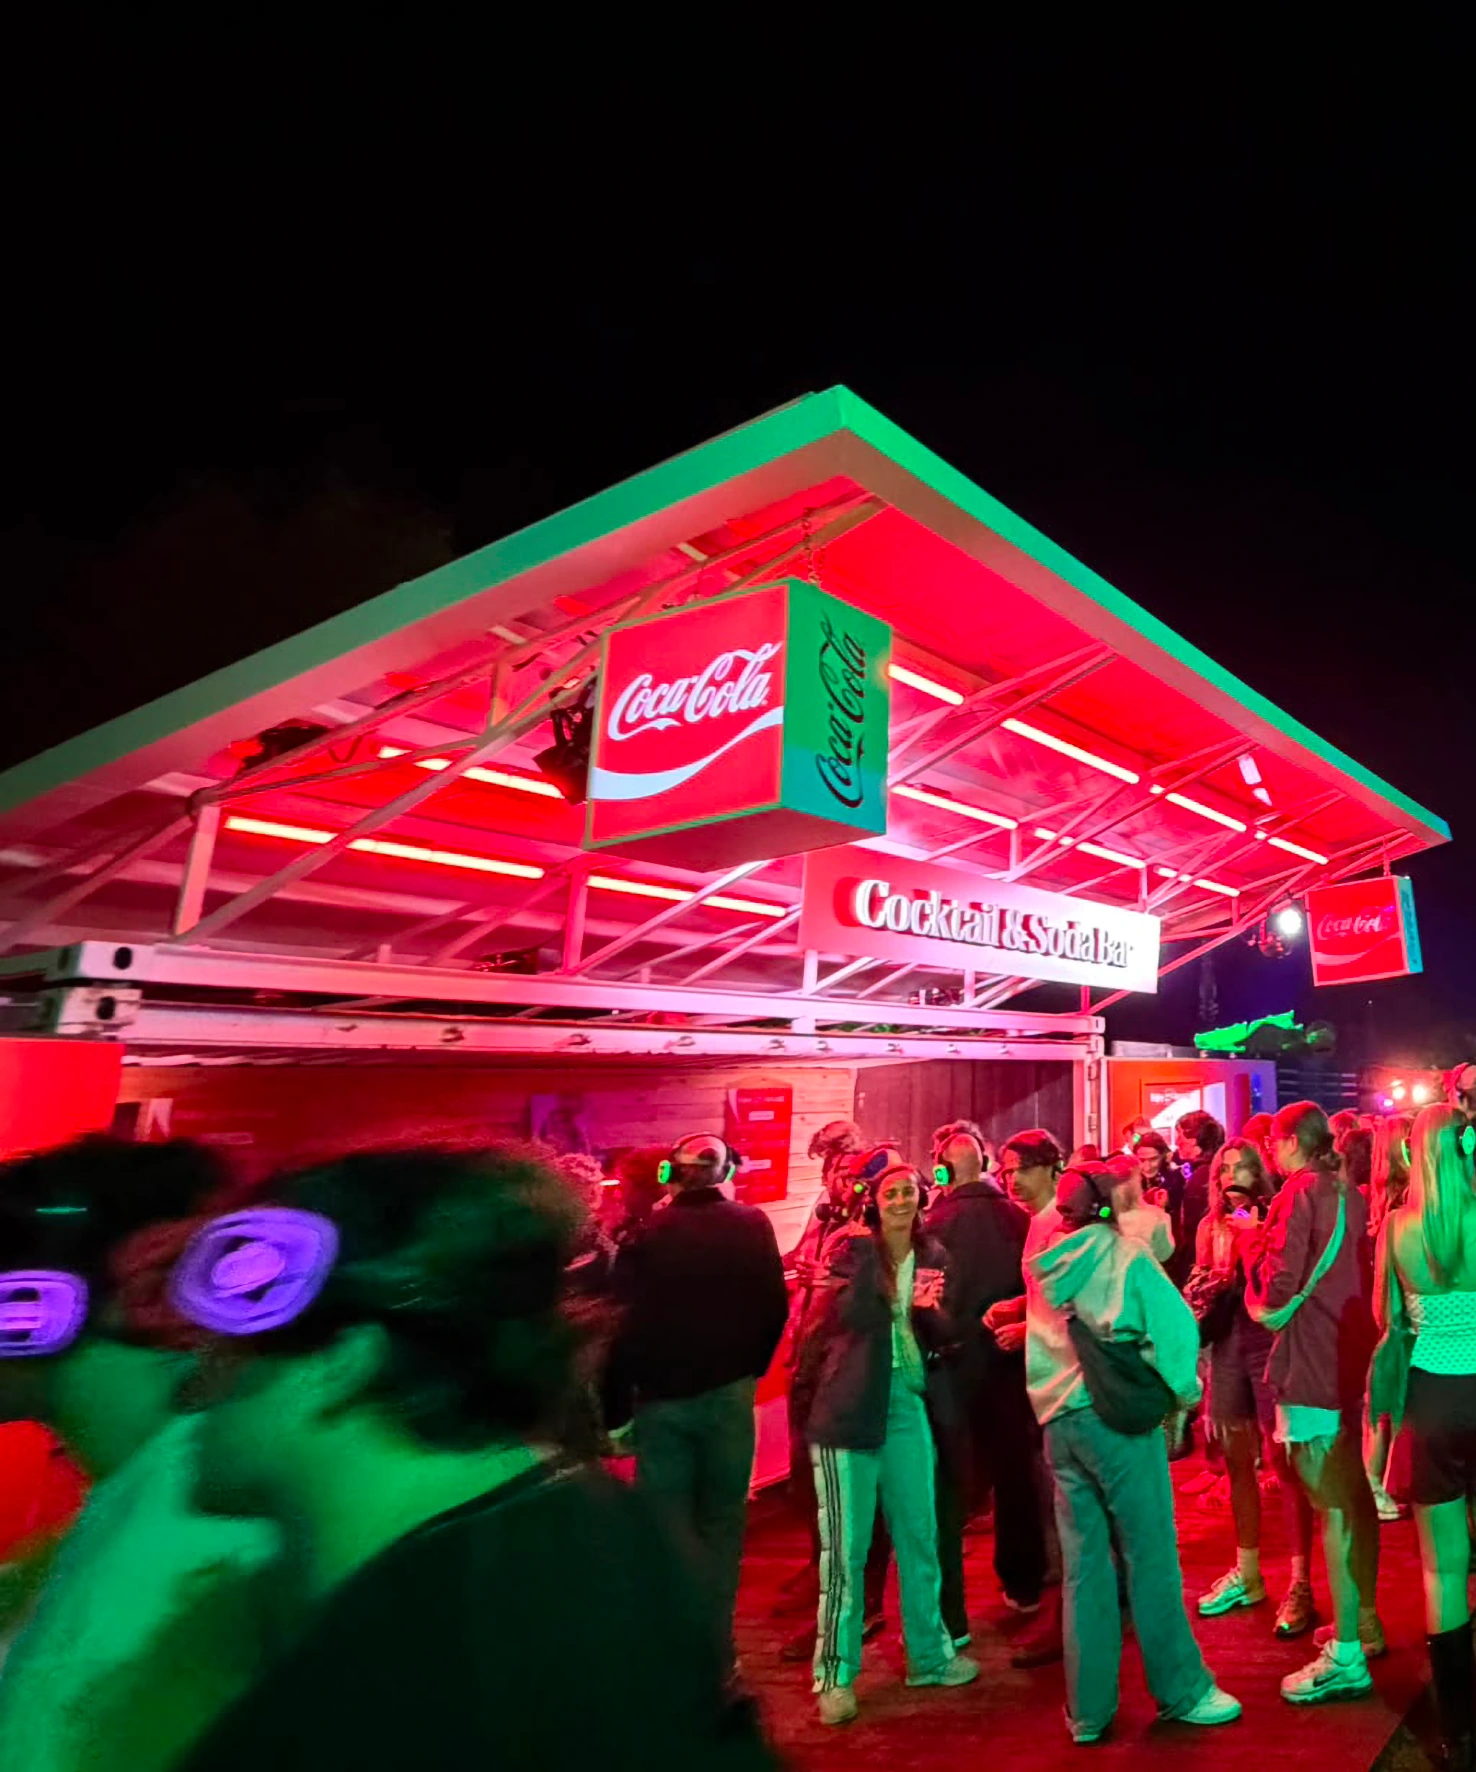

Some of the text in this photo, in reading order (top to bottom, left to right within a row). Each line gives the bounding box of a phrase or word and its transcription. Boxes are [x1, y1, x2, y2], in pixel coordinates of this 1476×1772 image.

[855, 879, 1000, 947] Cocktail
[1001, 905, 1028, 950] &
[1023, 911, 1094, 963] Soda
